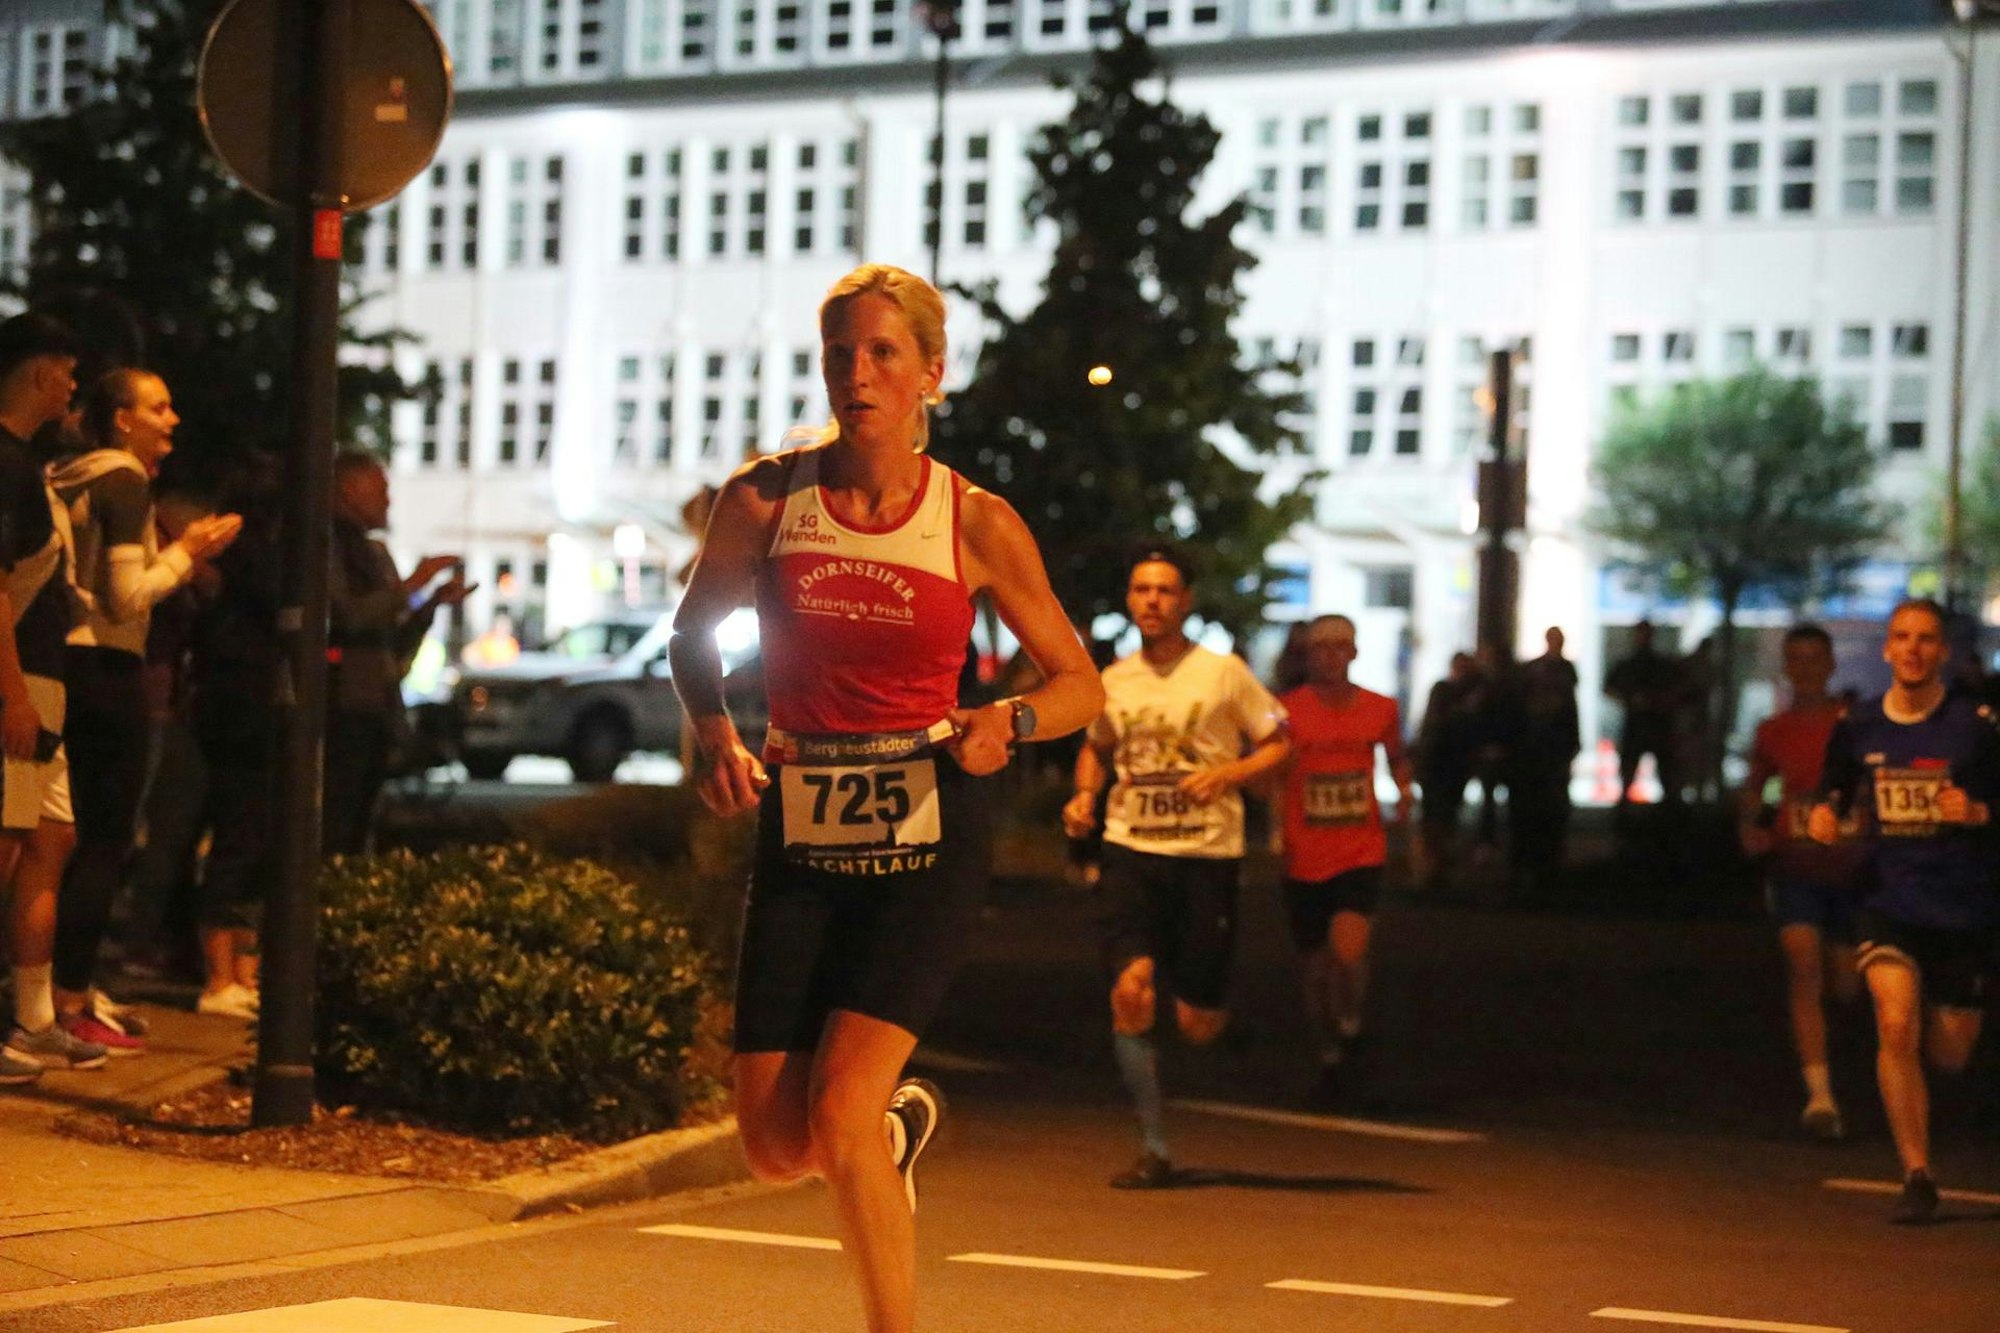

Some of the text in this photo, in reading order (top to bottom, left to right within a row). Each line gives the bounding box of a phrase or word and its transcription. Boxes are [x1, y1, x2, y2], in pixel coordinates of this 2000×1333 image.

[798, 514, 818, 528] SG
[798, 560, 915, 603] DORNSEIFER
[873, 603, 914, 619] frisch
[802, 771, 909, 824] 725
